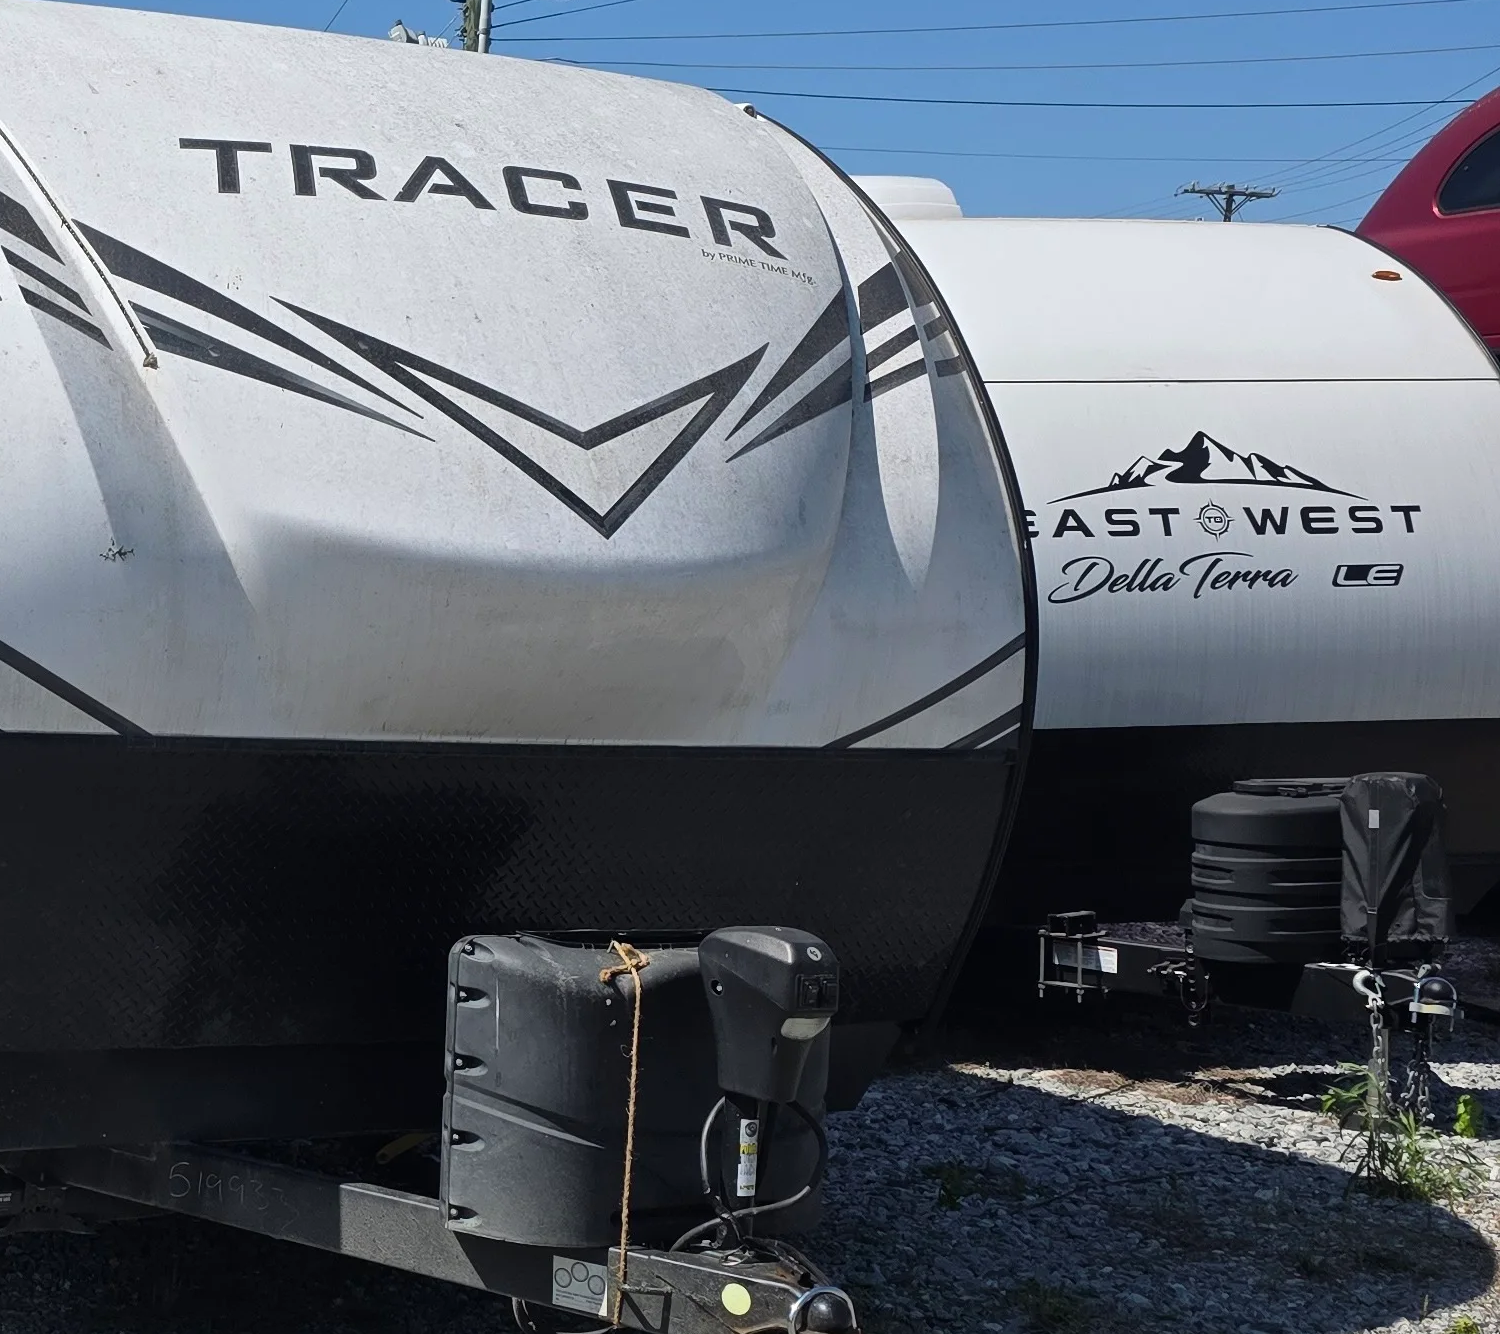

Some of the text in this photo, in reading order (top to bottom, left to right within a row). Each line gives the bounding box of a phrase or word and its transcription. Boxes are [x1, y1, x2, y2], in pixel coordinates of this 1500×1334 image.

[179, 138, 788, 260] TRACER
[701, 249, 716, 260] by
[719, 252, 757, 268] PRIME
[759, 261, 788, 276] TIME
[1242, 505, 1422, 535] WEST
[1047, 551, 1403, 604] Della Terra LE
